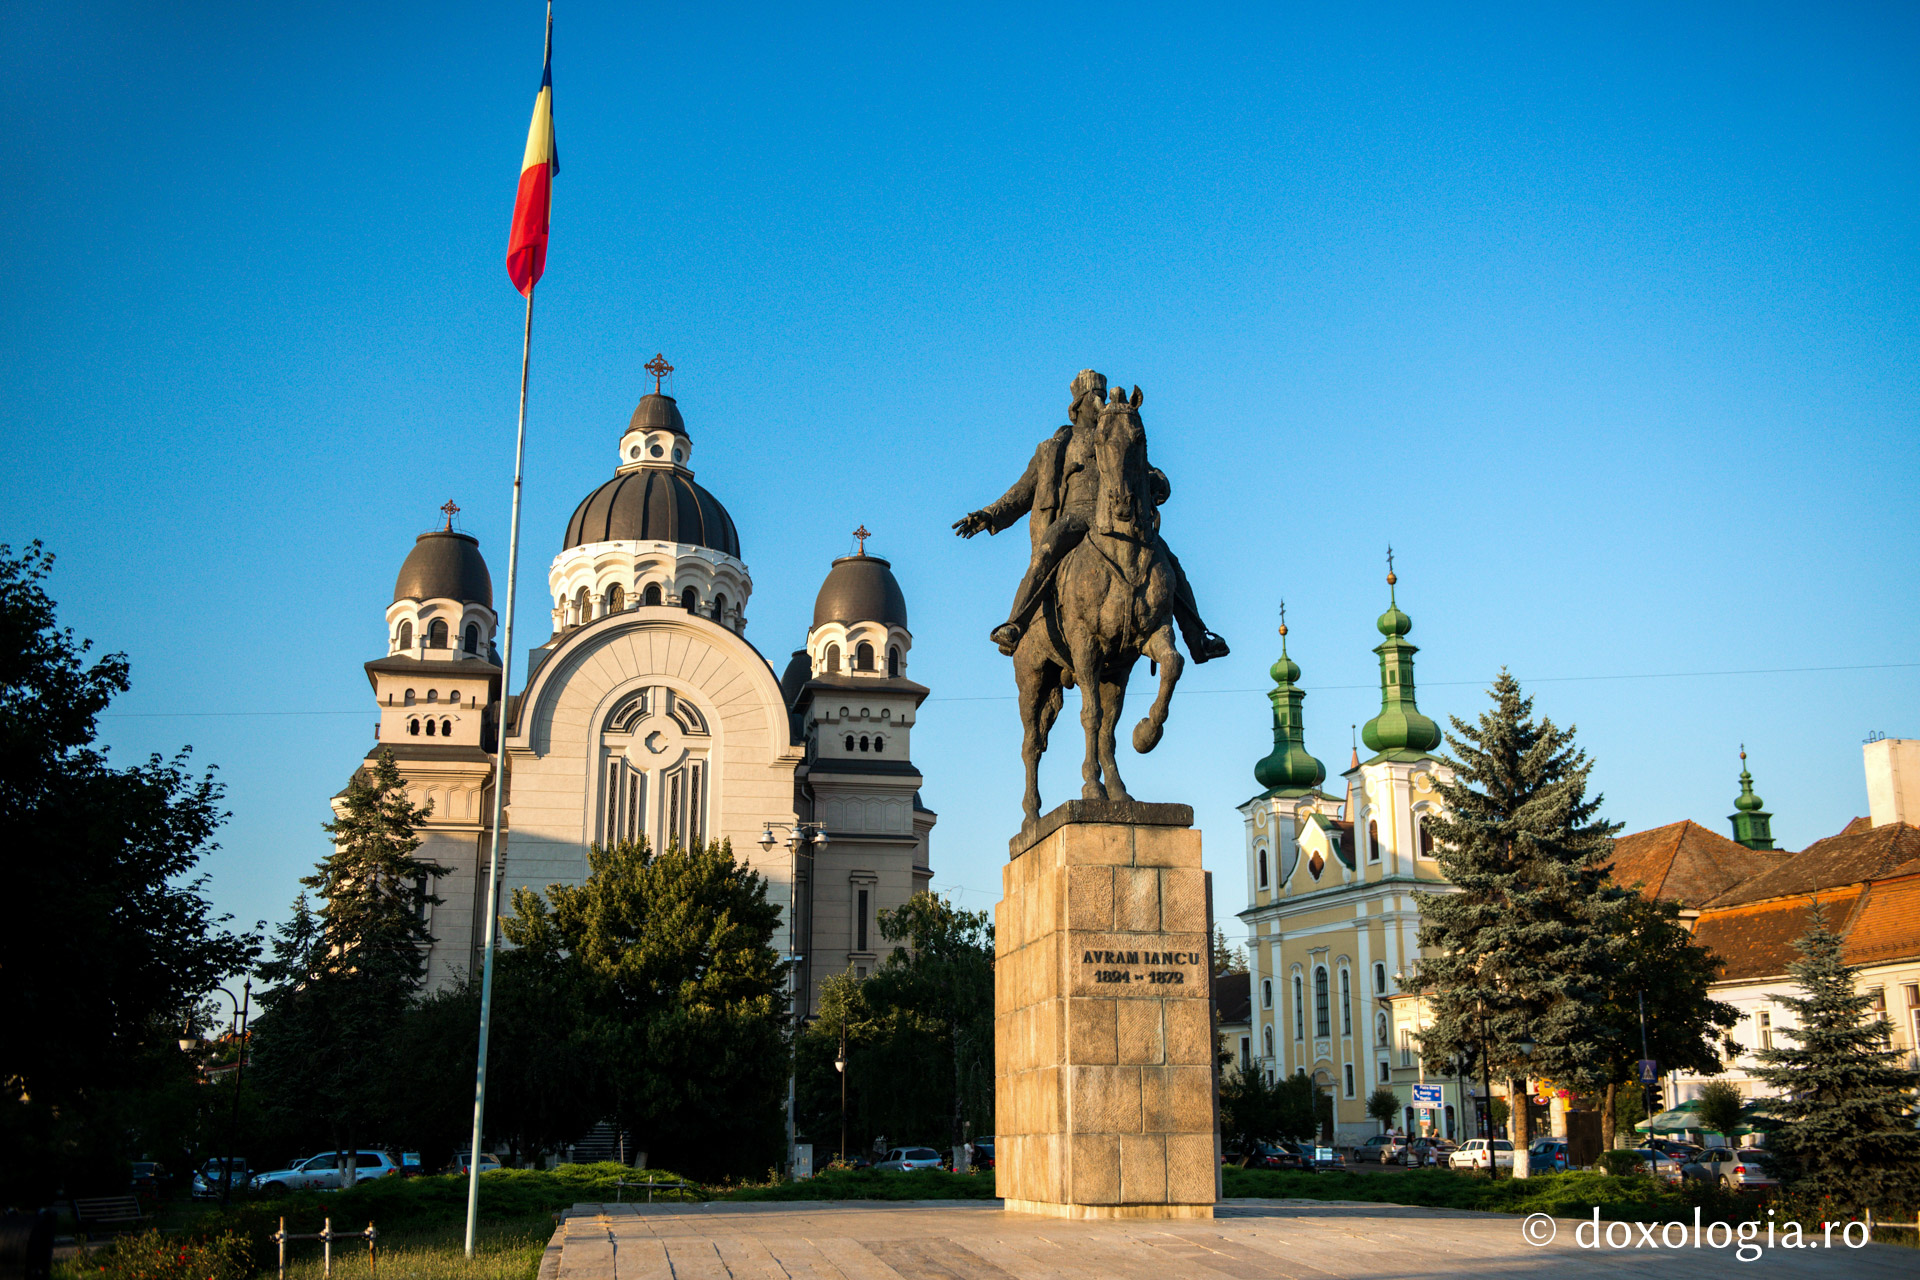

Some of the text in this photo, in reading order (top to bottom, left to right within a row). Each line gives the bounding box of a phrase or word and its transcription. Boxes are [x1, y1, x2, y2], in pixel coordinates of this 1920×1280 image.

[1083, 950, 1200, 965] AVRAM IANCU
[1094, 970, 1130, 984] 1824
[1148, 971, 1184, 984] 1872
